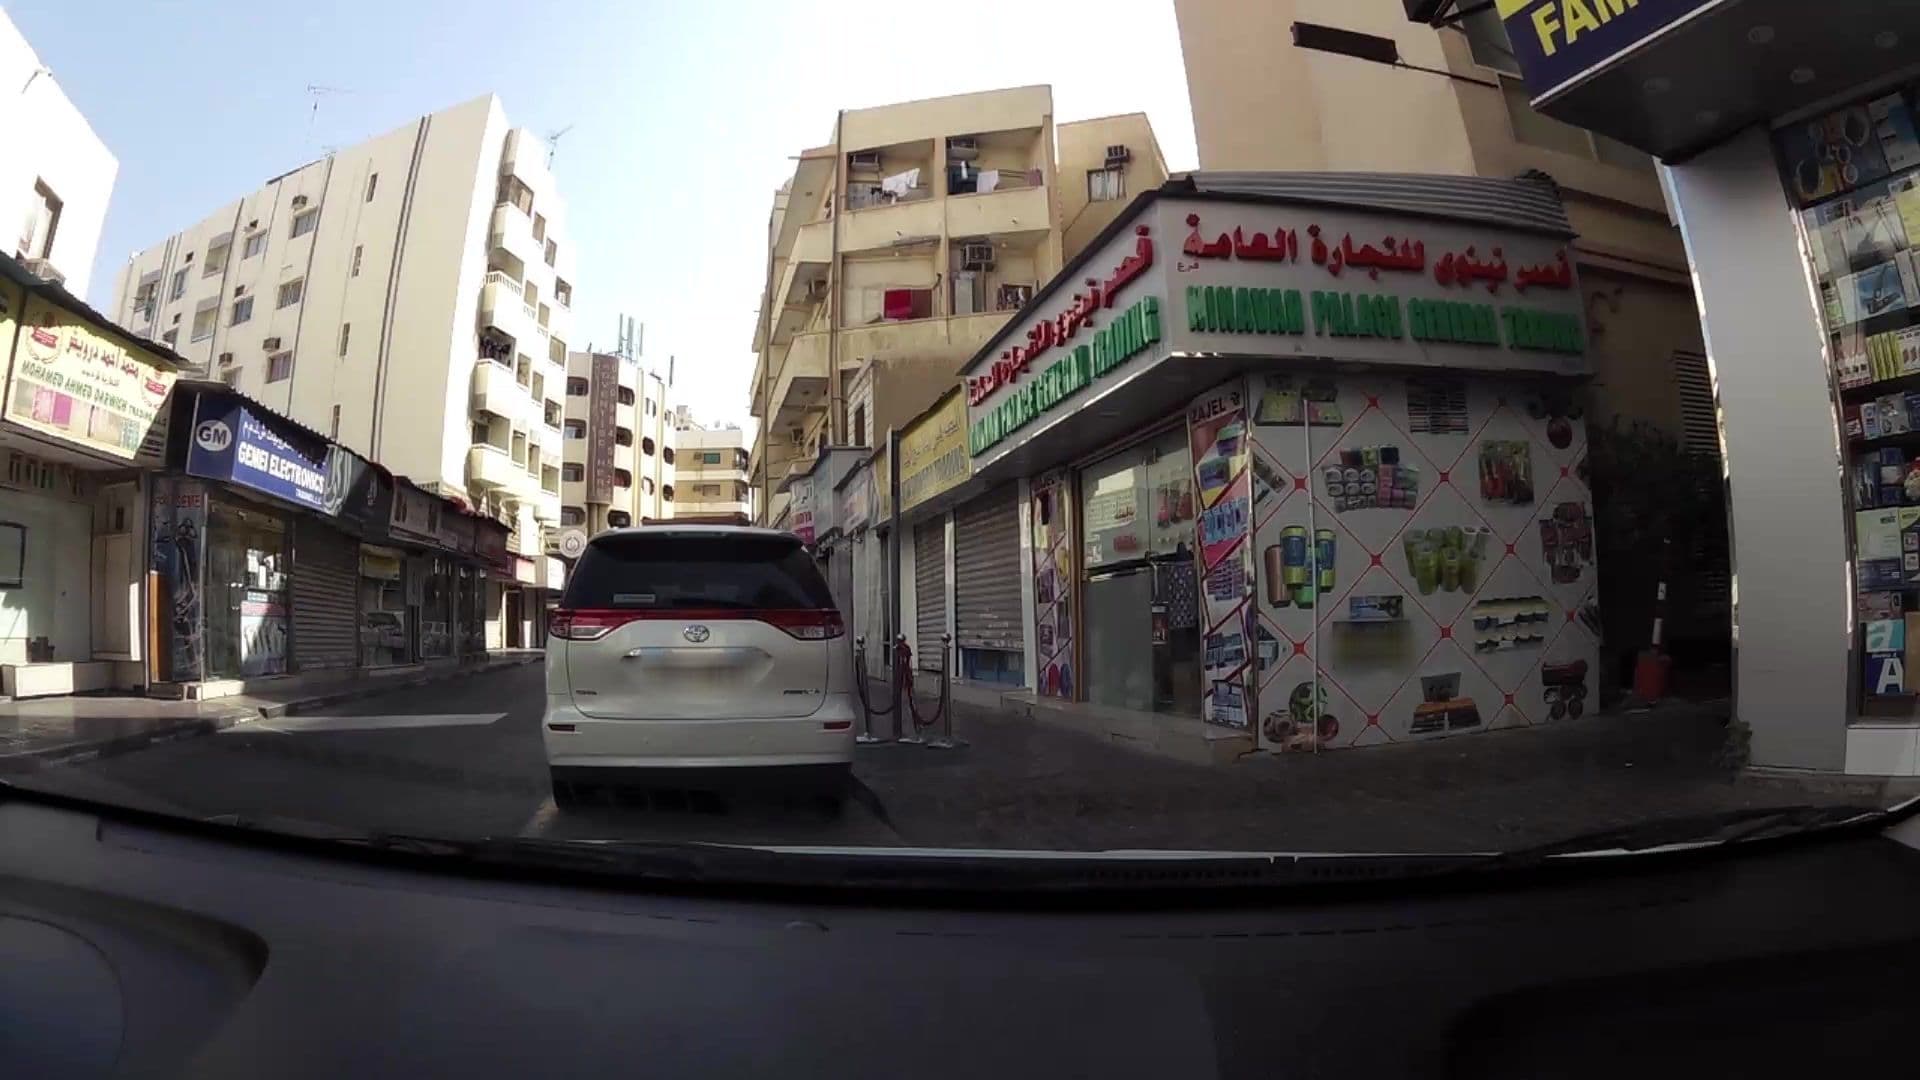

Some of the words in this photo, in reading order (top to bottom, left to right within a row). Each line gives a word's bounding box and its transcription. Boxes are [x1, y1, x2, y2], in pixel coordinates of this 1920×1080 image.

[1183, 213, 1298, 265] العامة
[1307, 224, 1424, 281] للتجارة
[1434, 245, 1507, 294] نينوى
[1514, 249, 1571, 293] قصر
[1088, 295, 1161, 379] TRADING
[22, 360, 65, 390] MOHAMED
[65, 377, 93, 401] AHMED
[198, 426, 227, 445] GM
[269, 454, 325, 495] ELECTRONICS
